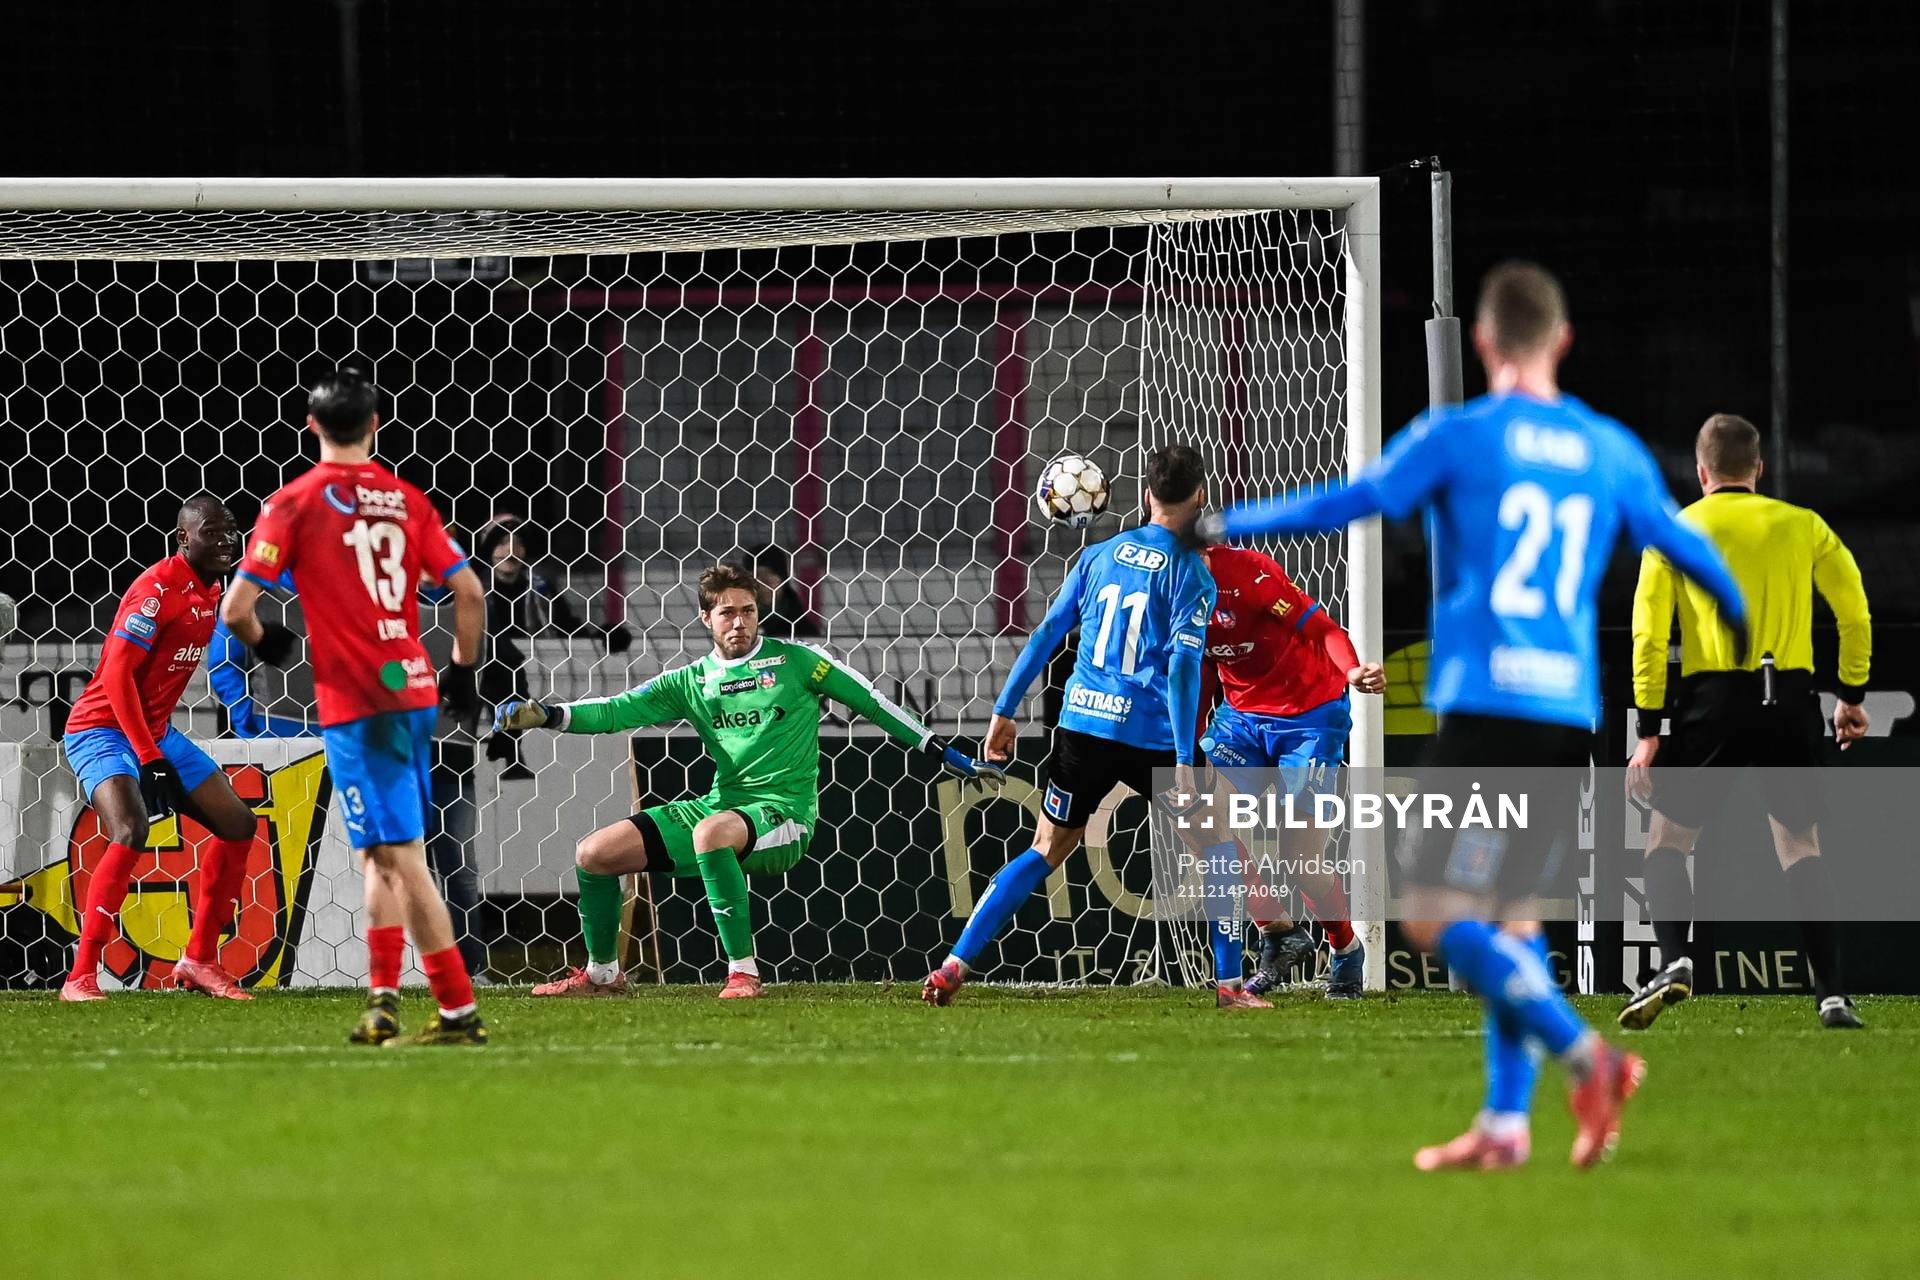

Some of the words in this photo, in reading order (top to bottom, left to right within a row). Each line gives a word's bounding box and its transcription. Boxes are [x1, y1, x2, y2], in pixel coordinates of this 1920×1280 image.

[342, 519, 407, 613] 13
[1117, 549, 1164, 570] EAB
[1490, 481, 1594, 620] 21
[1091, 584, 1149, 676] 11
[1069, 684, 1125, 714] ÖSTRAS
[712, 709, 761, 729] akea
[1308, 757, 1327, 788] 14
[337, 785, 365, 819] 13
[1217, 916, 1231, 935] GN
